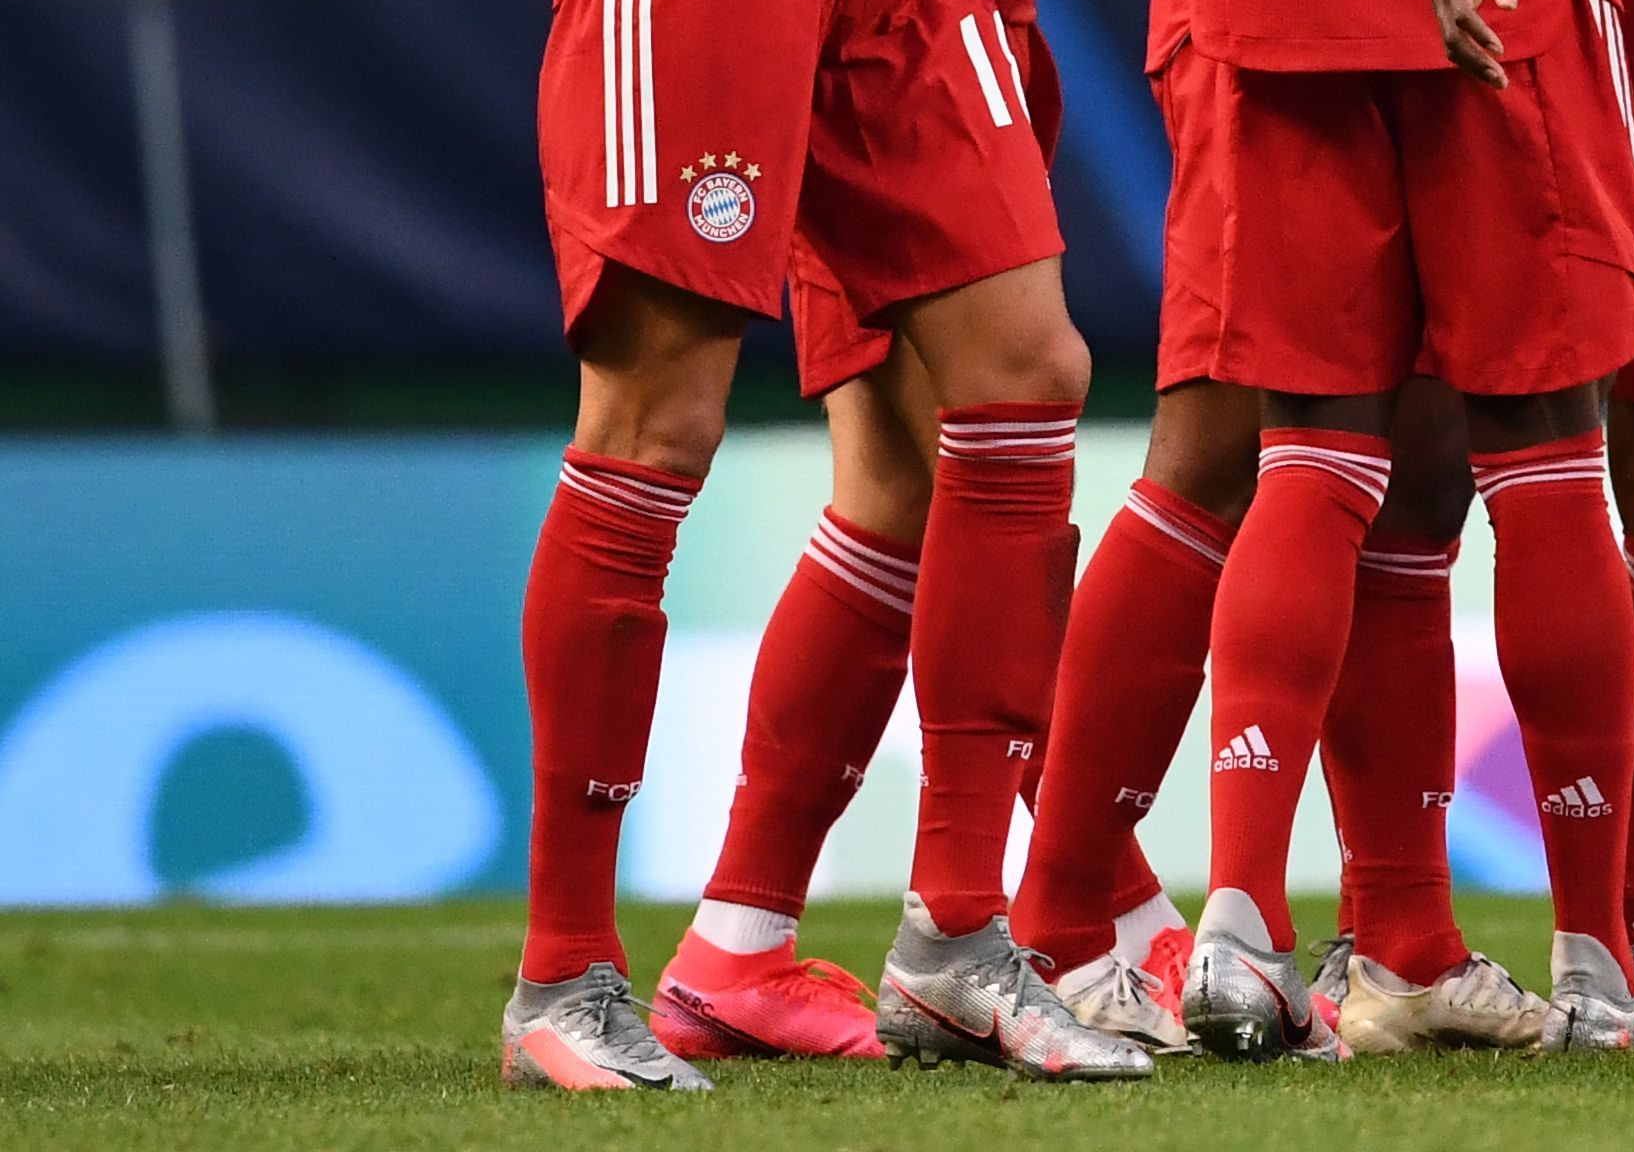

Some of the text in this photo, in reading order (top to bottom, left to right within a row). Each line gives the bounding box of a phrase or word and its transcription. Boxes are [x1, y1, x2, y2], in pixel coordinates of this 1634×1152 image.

[706, 177, 749, 204] BAYERN
[1213, 753, 1280, 773] adidas
[1540, 801, 1614, 819] adidas
